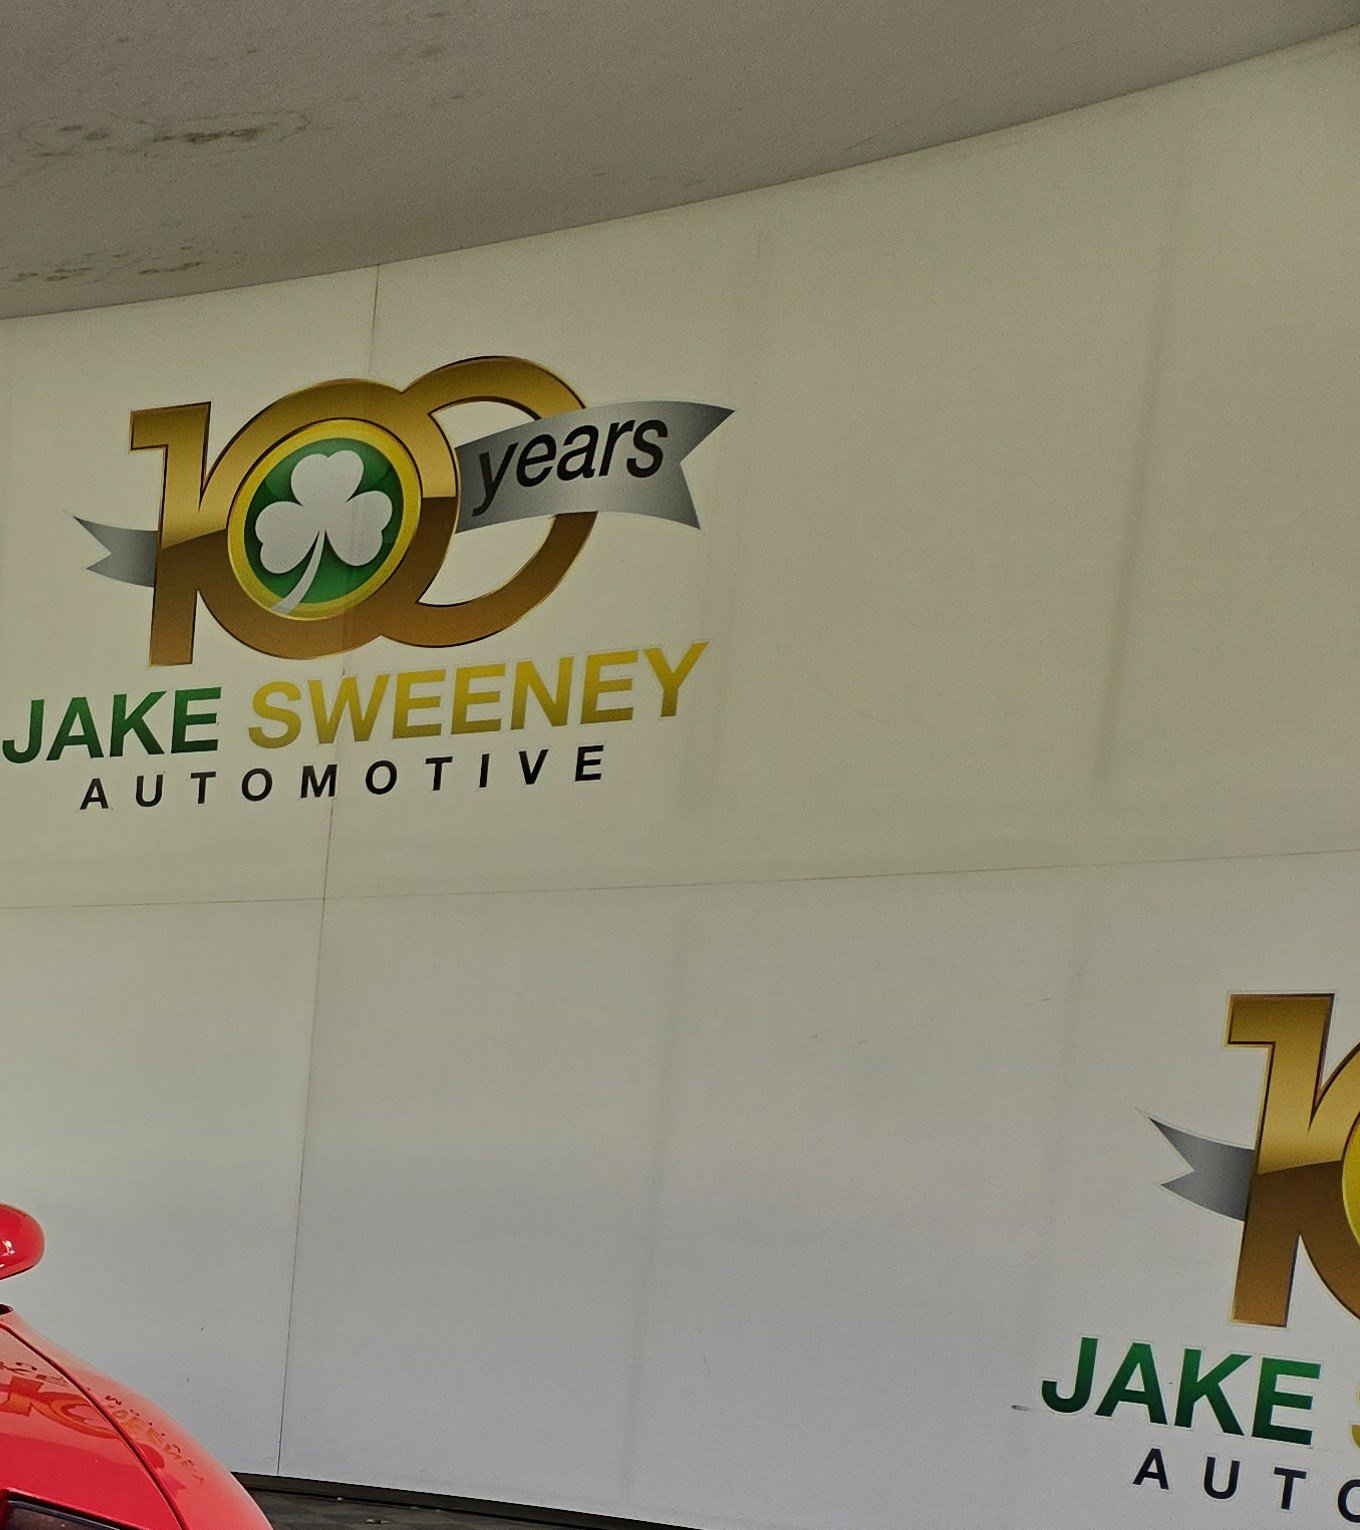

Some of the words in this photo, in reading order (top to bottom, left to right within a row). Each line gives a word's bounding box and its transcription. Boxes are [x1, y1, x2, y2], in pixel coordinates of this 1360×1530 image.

[129, 355, 598, 666] 100
[472, 419, 669, 517] years
[2, 687, 222, 764] JAKE
[247, 642, 710, 750] SWEENEY
[79, 745, 605, 811] AUTOMOTIVE
[1041, 1336, 1322, 1446] JAKE
